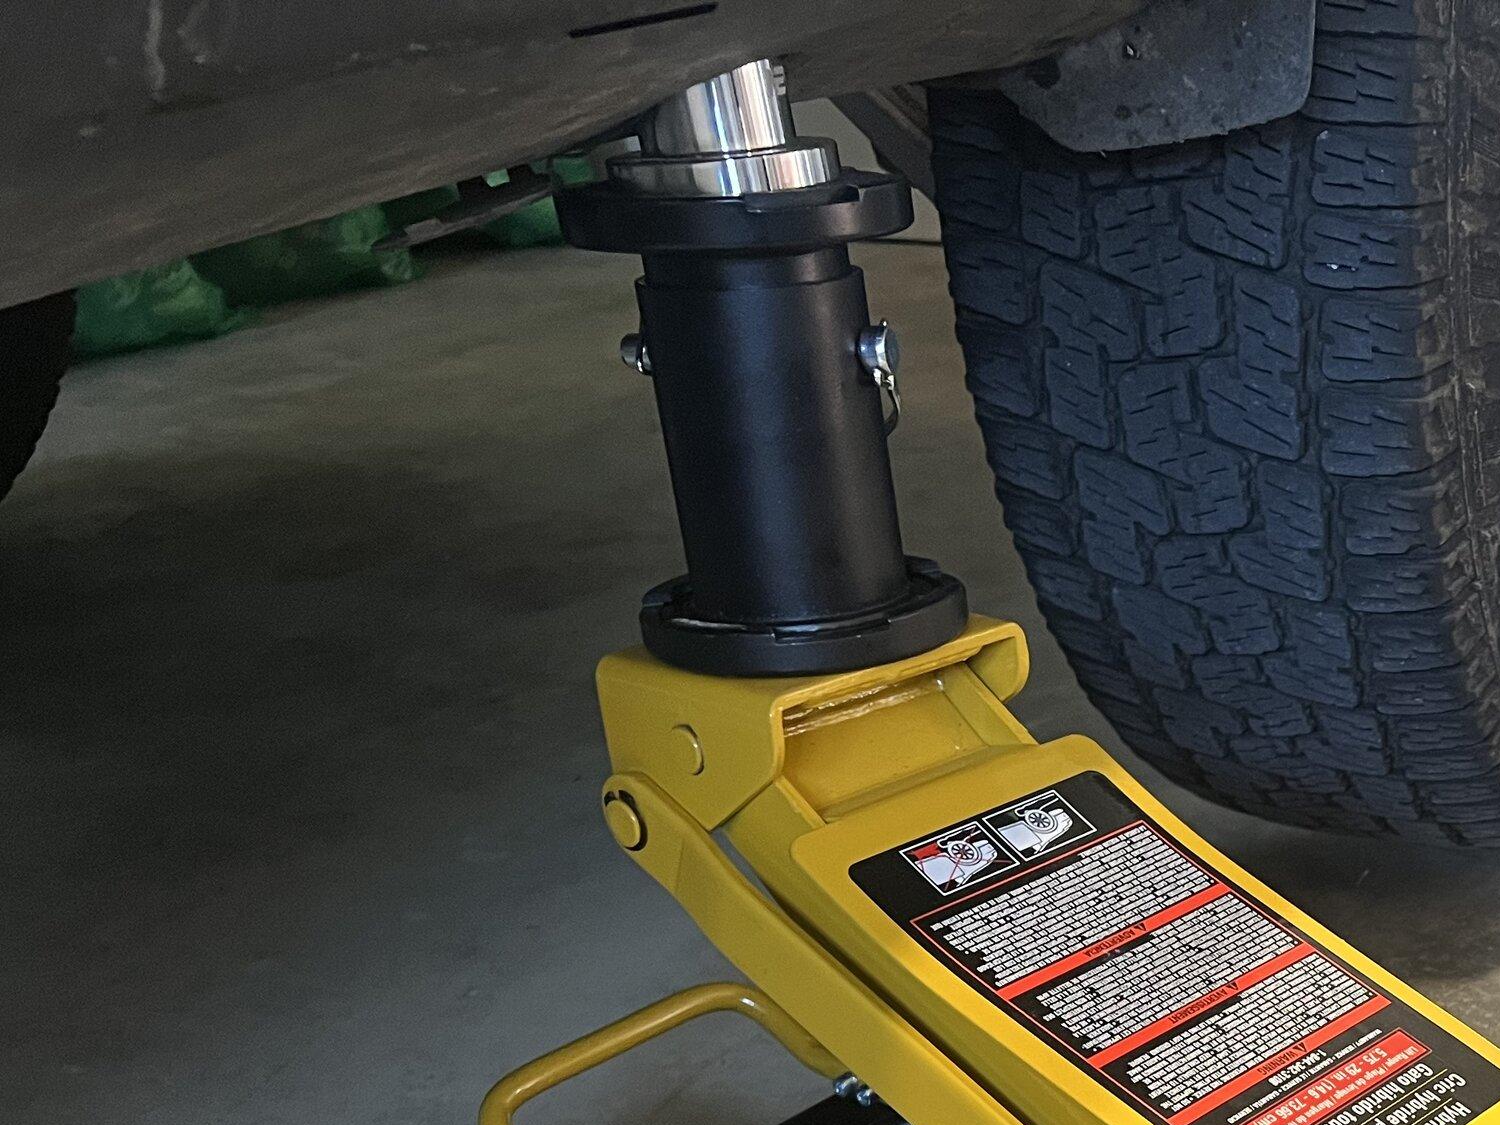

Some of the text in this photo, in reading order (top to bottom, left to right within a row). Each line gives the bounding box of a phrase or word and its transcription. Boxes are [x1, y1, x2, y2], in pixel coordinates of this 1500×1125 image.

[1082, 928, 1136, 957] ADVERTENCIA
[1167, 987, 1228, 1024] AVERTISSEMENT
[1256, 1050, 1298, 1075] WARNING
[1343, 1062, 1362, 1076] 29
[1384, 1051, 1409, 1067] Range
[1354, 1077, 1366, 1086] de
[1363, 1066, 1386, 1080] Plage
[1396, 1062, 1433, 1086] Gato
[1432, 1072, 1466, 1094] Cric
[1271, 1094, 1307, 1119] 73.66
[1303, 1098, 1334, 1118] Margen
[1350, 1081, 1405, 1115] híbrido
[1385, 1089, 1441, 1125] hybride
[1294, 1114, 1307, 1123] de
